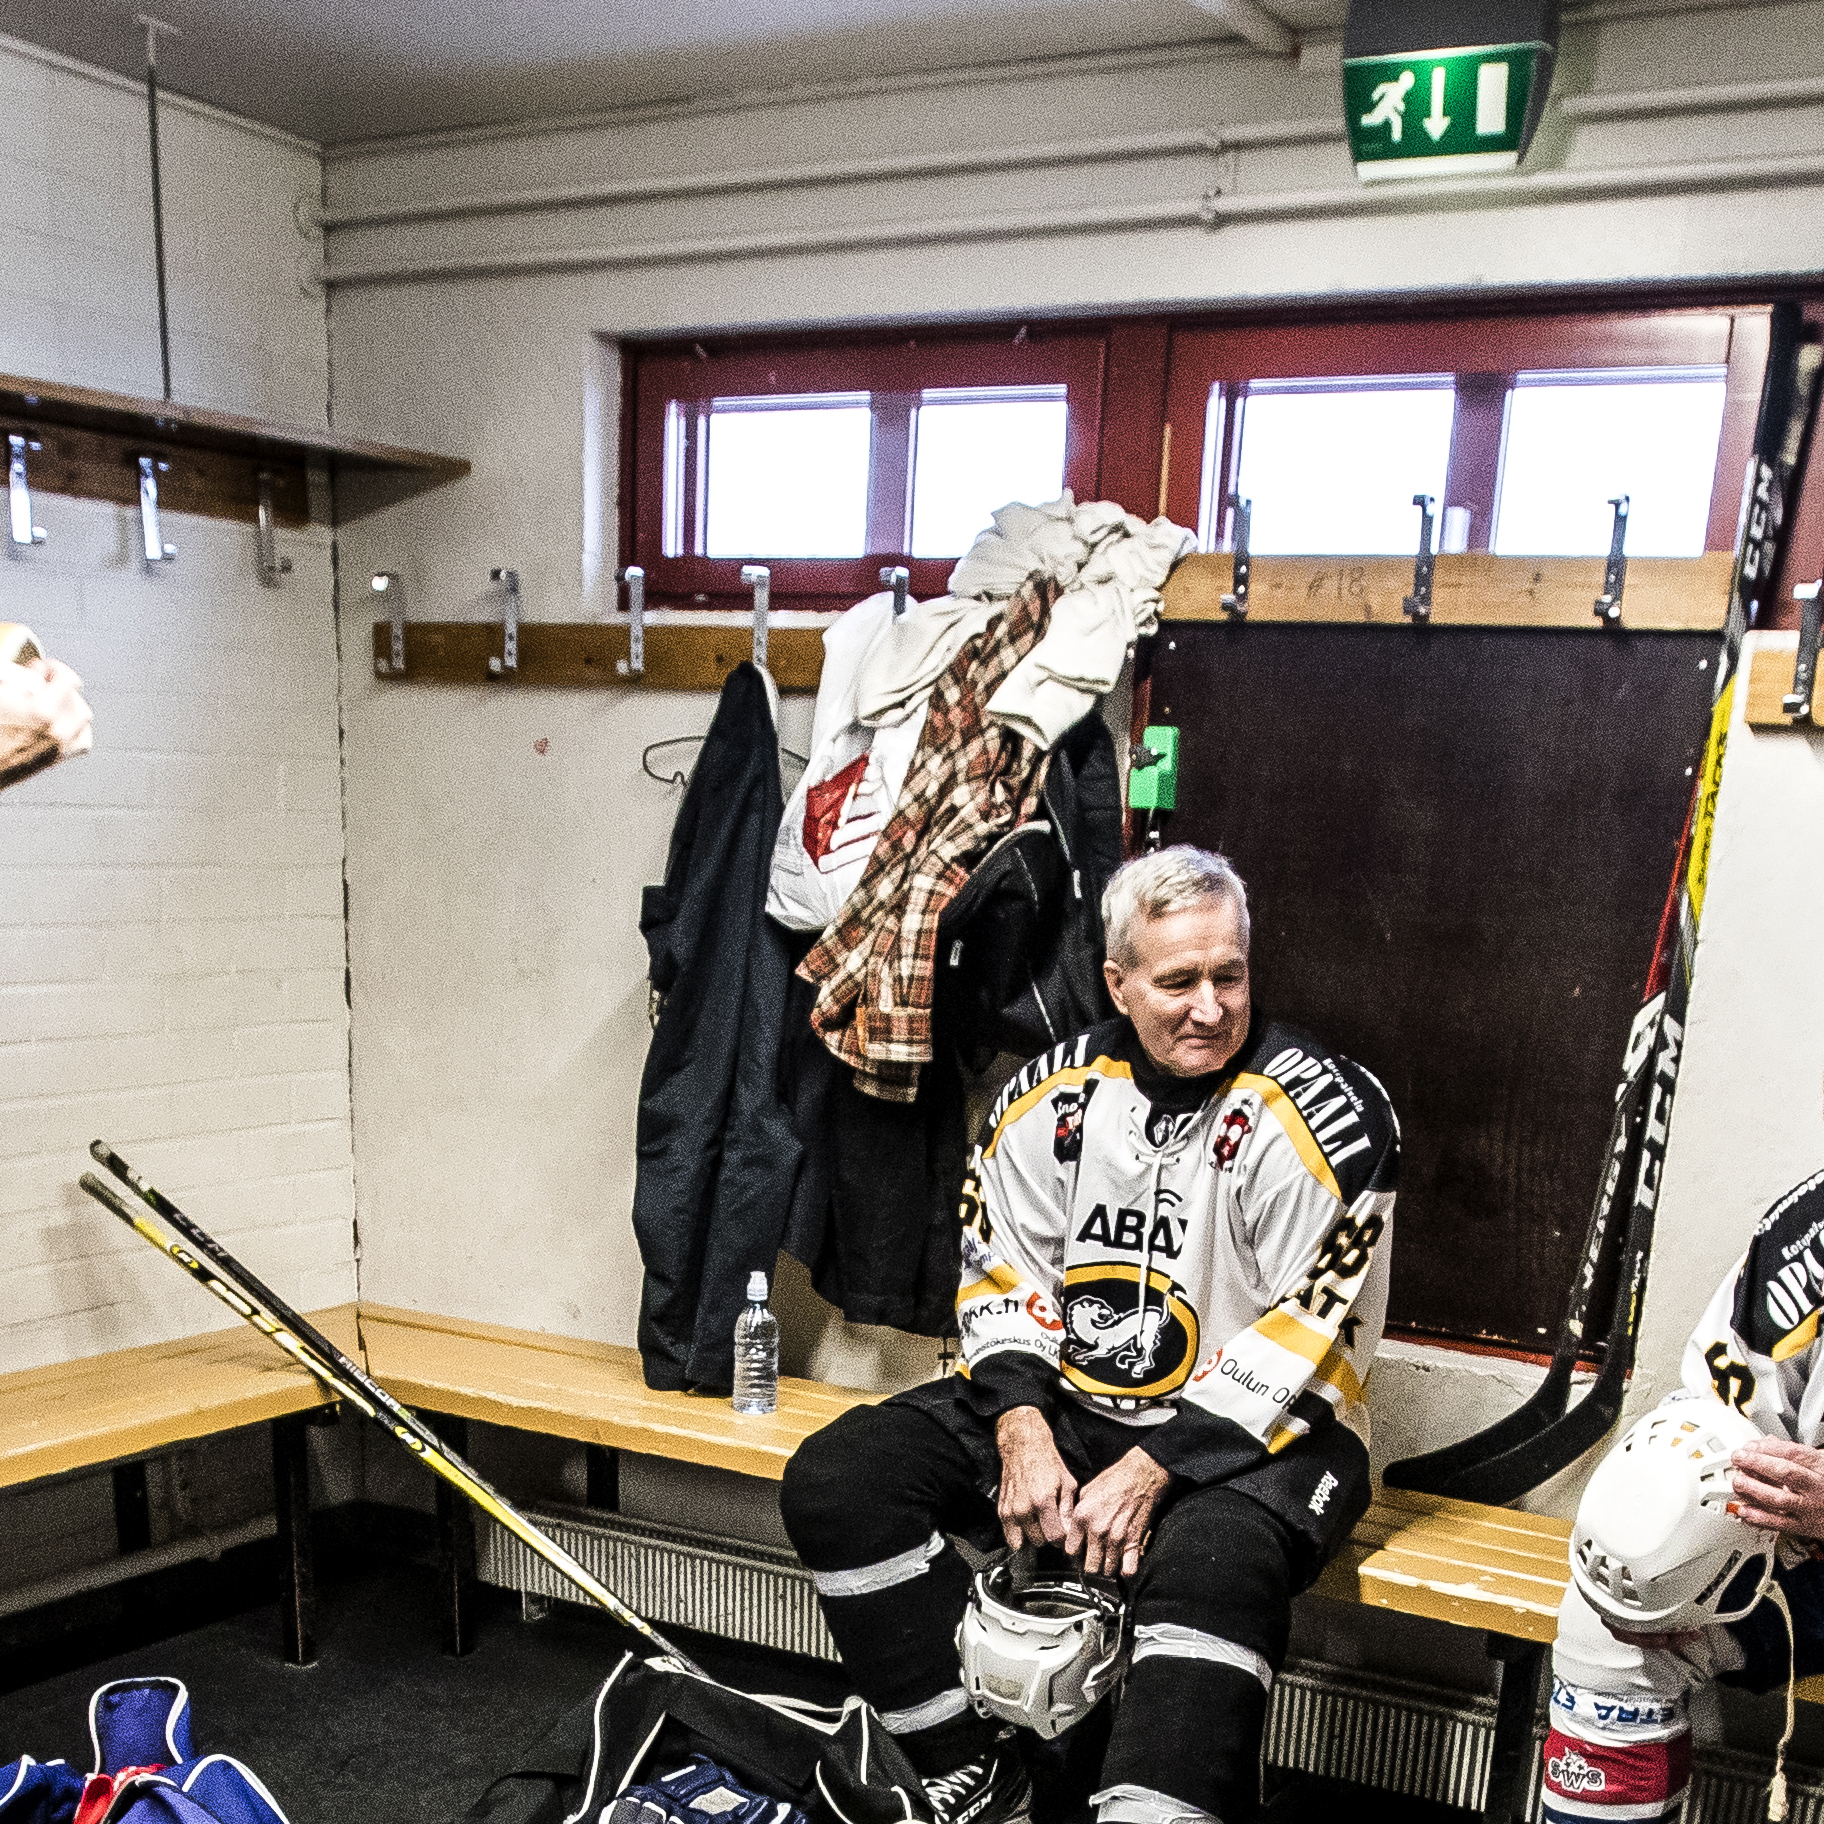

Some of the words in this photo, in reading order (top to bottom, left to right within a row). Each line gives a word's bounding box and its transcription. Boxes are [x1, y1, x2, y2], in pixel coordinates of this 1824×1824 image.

[1263, 1047, 1372, 1169] OPAALI
[1632, 1012, 1683, 1209] CCM
[1220, 1358, 1270, 1396] Oulun
[1308, 1470, 1339, 1516] Reebok
